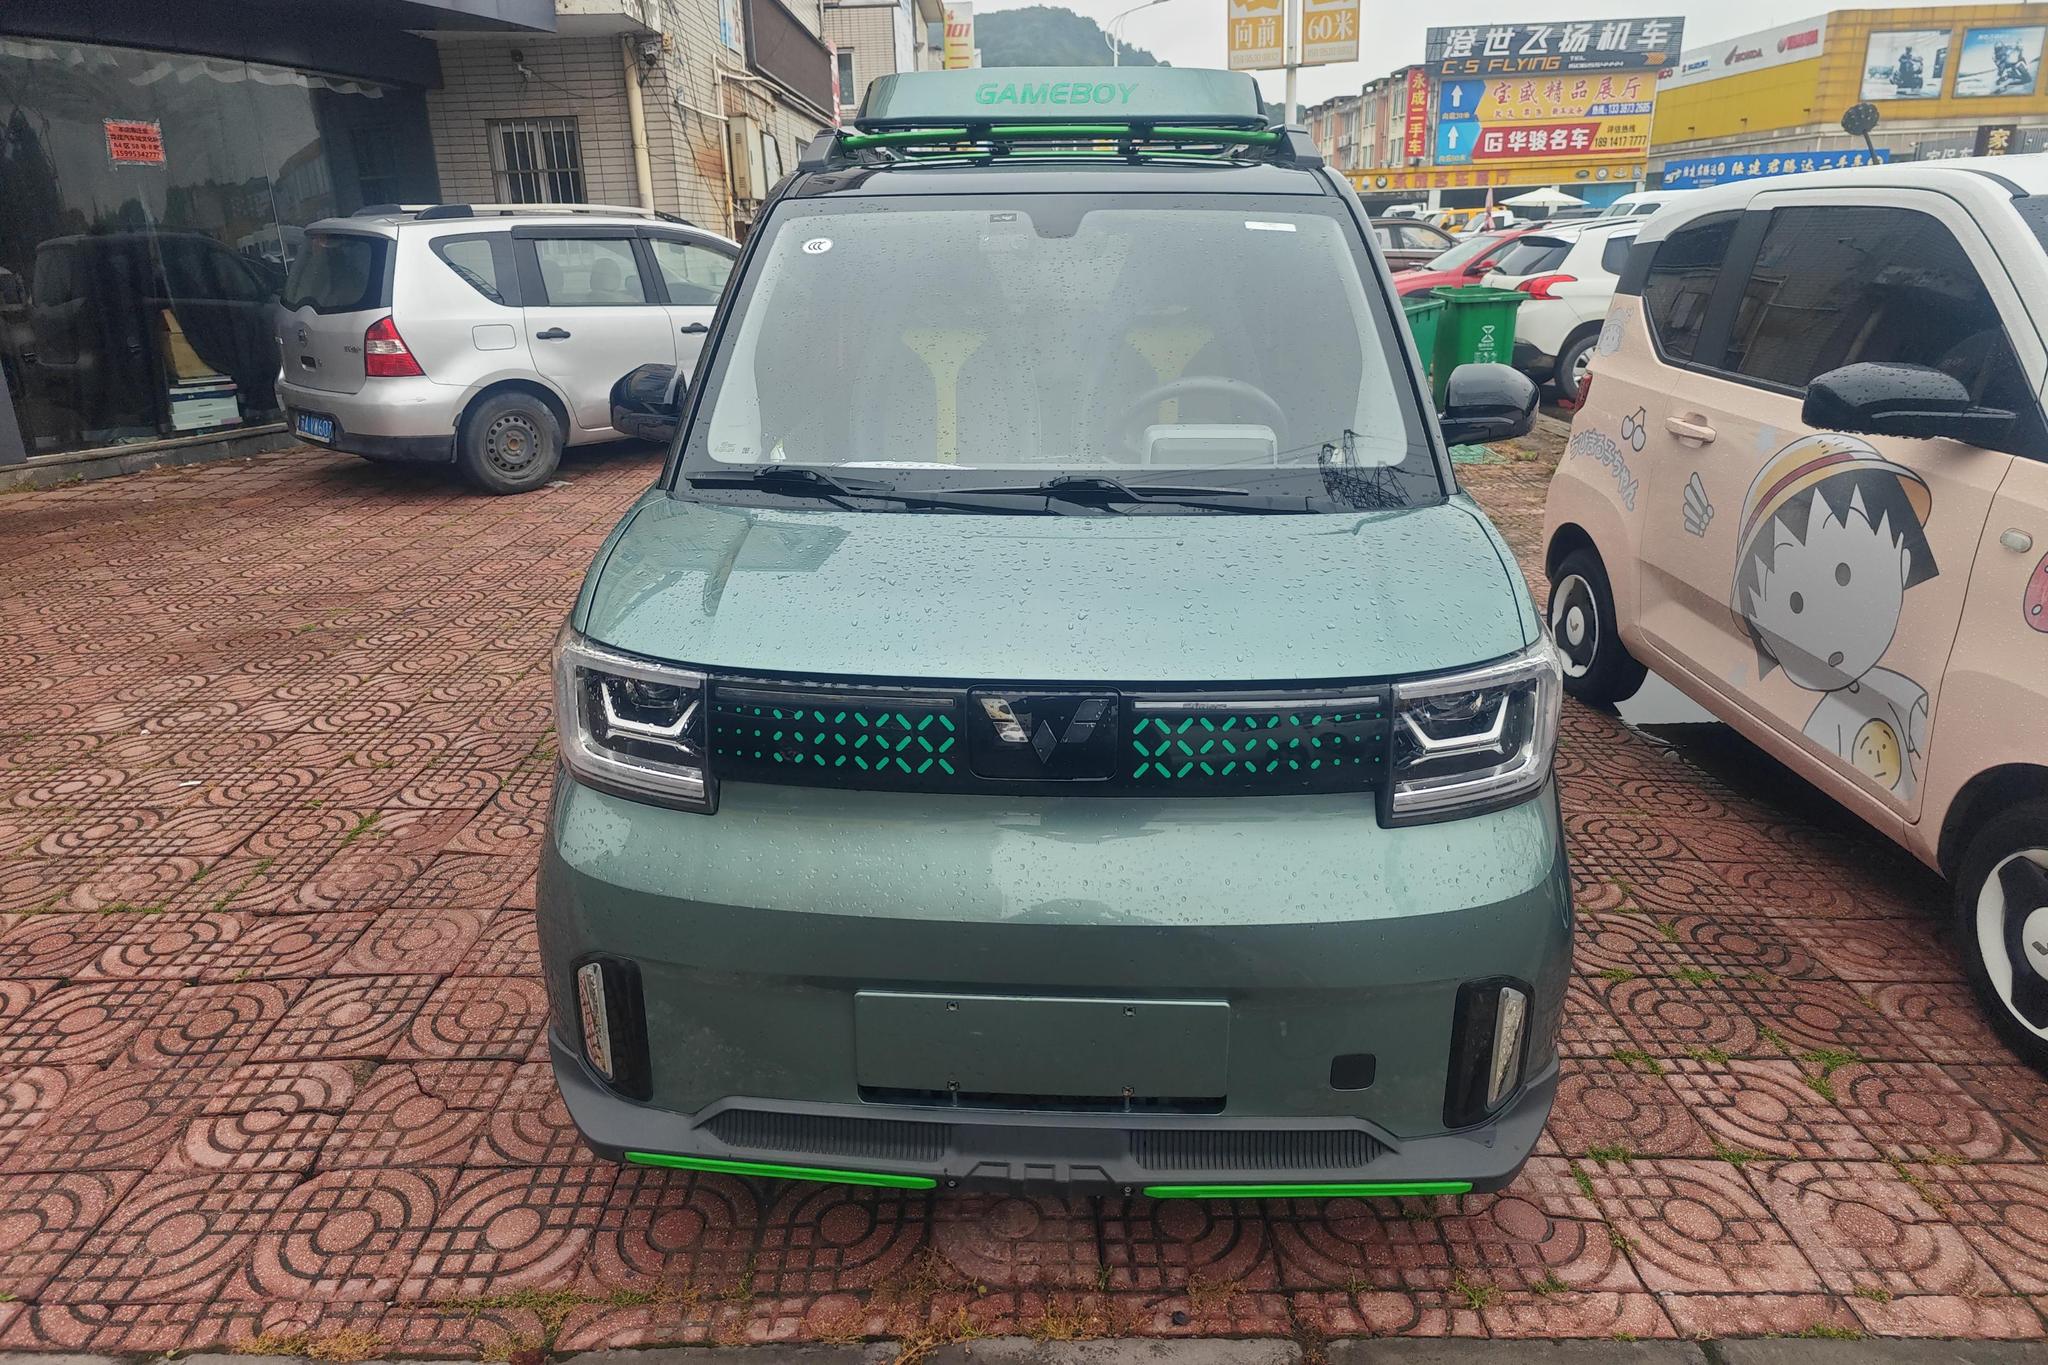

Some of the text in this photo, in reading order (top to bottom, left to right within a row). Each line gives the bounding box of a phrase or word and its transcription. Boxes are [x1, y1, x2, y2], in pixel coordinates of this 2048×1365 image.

[1235, 18, 1275, 48] 向前
[1308, 10, 1353, 40] 60米
[1442, 20, 1672, 58] 澄世飞扬机车
[1487, 56, 1562, 72] FLYING
[976, 83, 1140, 105] GAMEBOY
[1493, 76, 1642, 104] 宝盛精品展厅
[1408, 73, 1426, 154] 永成二手车
[1508, 127, 1590, 152] 华骏名车
